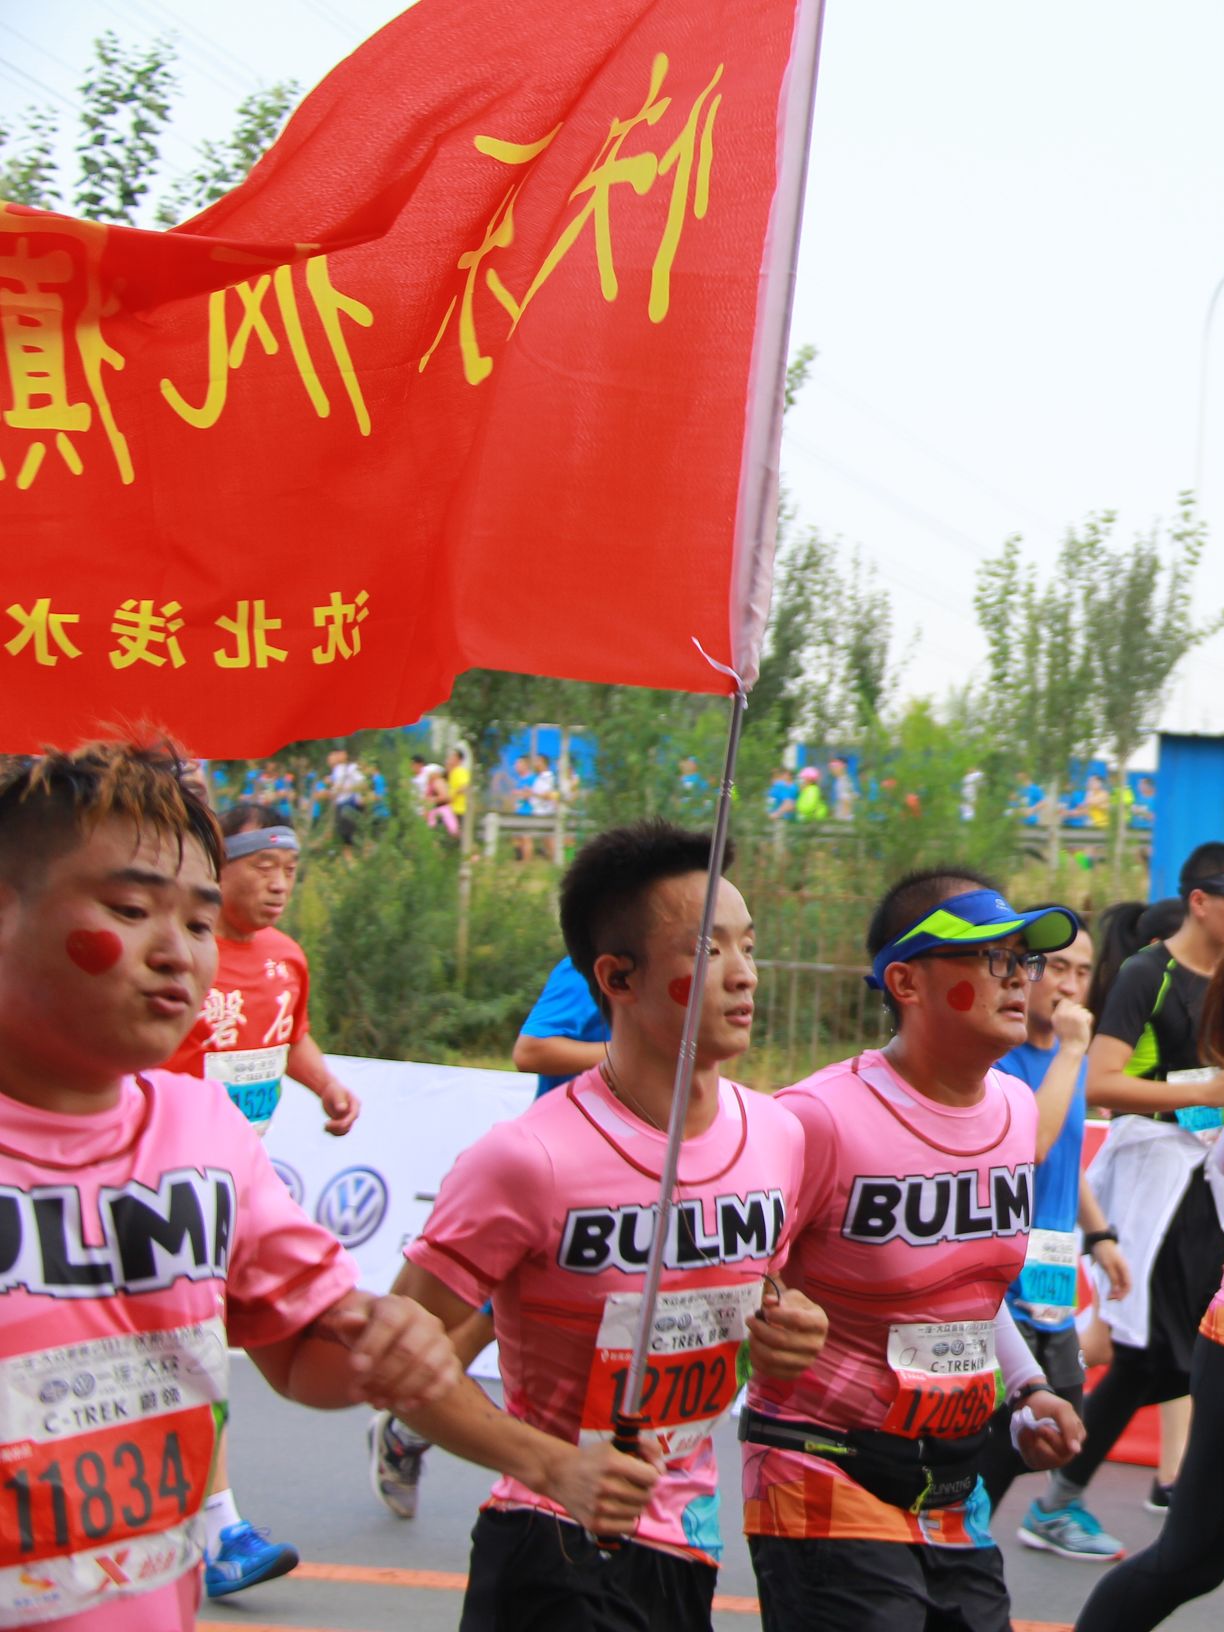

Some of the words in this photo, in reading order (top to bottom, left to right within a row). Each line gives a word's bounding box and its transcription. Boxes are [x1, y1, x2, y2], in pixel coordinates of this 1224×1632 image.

[558, 1188, 787, 1276] BULM
[651, 1333, 704, 1351] C-TREK
[42, 1397, 129, 1434] C-TREK
[608, 1356, 727, 1425] 12702
[5, 1430, 192, 1553] 11834
